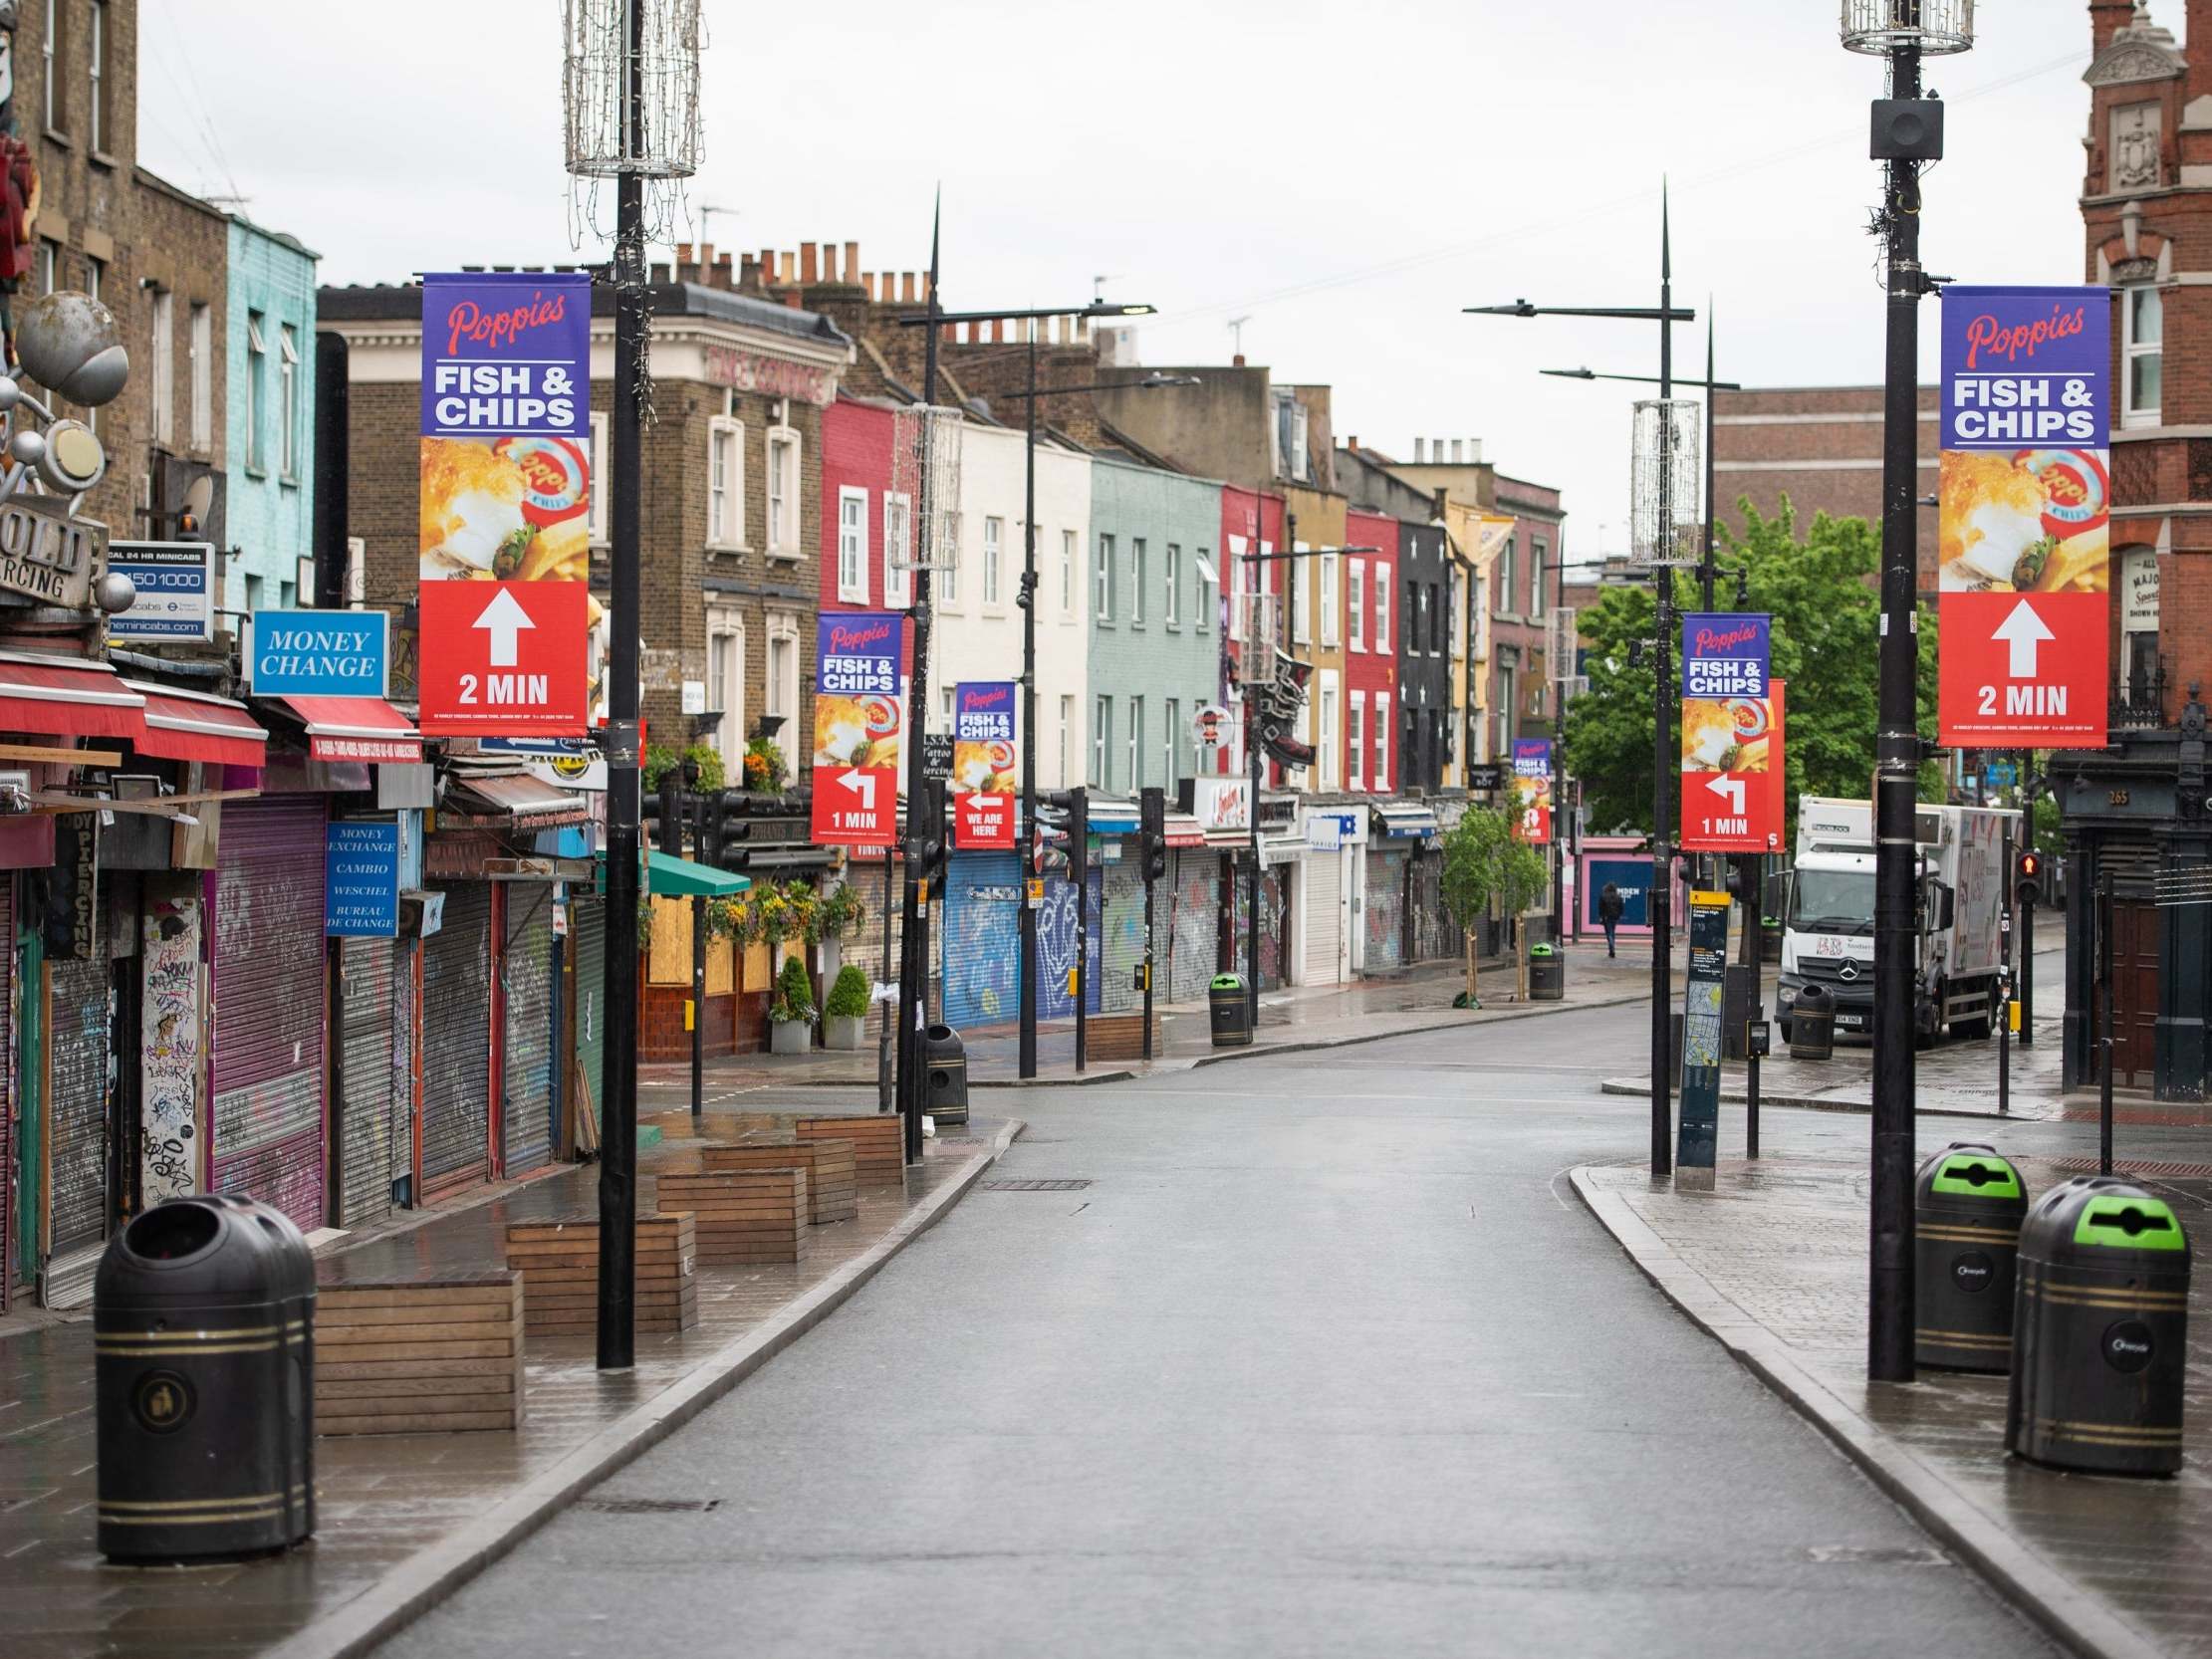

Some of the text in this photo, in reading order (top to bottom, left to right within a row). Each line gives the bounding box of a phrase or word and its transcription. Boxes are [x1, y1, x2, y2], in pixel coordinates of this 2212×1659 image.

[448, 291, 565, 356] Poppies
[1967, 304, 2085, 369] Poppies
[435, 366, 575, 395] FISH &
[1954, 378, 2094, 407] FISH &
[435, 397, 575, 426] CHIPS
[1954, 410, 2094, 439] CHIPS
[156, 553, 201, 562] MINICABS
[0, 559, 65, 598] RCING
[159, 574, 200, 587] 1000
[267, 630, 371, 651] MONEY
[830, 621, 889, 653] Poppies
[1695, 621, 1757, 657] Poppies
[261, 655, 375, 677] CHANGE
[824, 658, 893, 675] FISH &
[1689, 661, 1761, 677] FISH &
[459, 674, 547, 704] 2 MIN
[824, 674, 893, 690] CHIPS
[1689, 677, 1762, 693] CHIPS
[1978, 685, 2067, 716] 2 MIN
[959, 714, 1010, 726] FISH &
[960, 726, 1010, 738] CHIPS
[2109, 791, 2128, 805] 265
[833, 812, 876, 829] 1 MIN
[966, 814, 1003, 825] WE ARE
[1702, 819, 1748, 834] 1 MIN
[340, 829, 385, 838] MONEY
[972, 825, 998, 836] HERE
[329, 842, 395, 852] EXCHANGE
[336, 864, 388, 873] CAMBIO
[334, 886, 389, 895] WESCHEL
[336, 906, 385, 916] BUREAU
[327, 918, 394, 928] DE CHANGE
